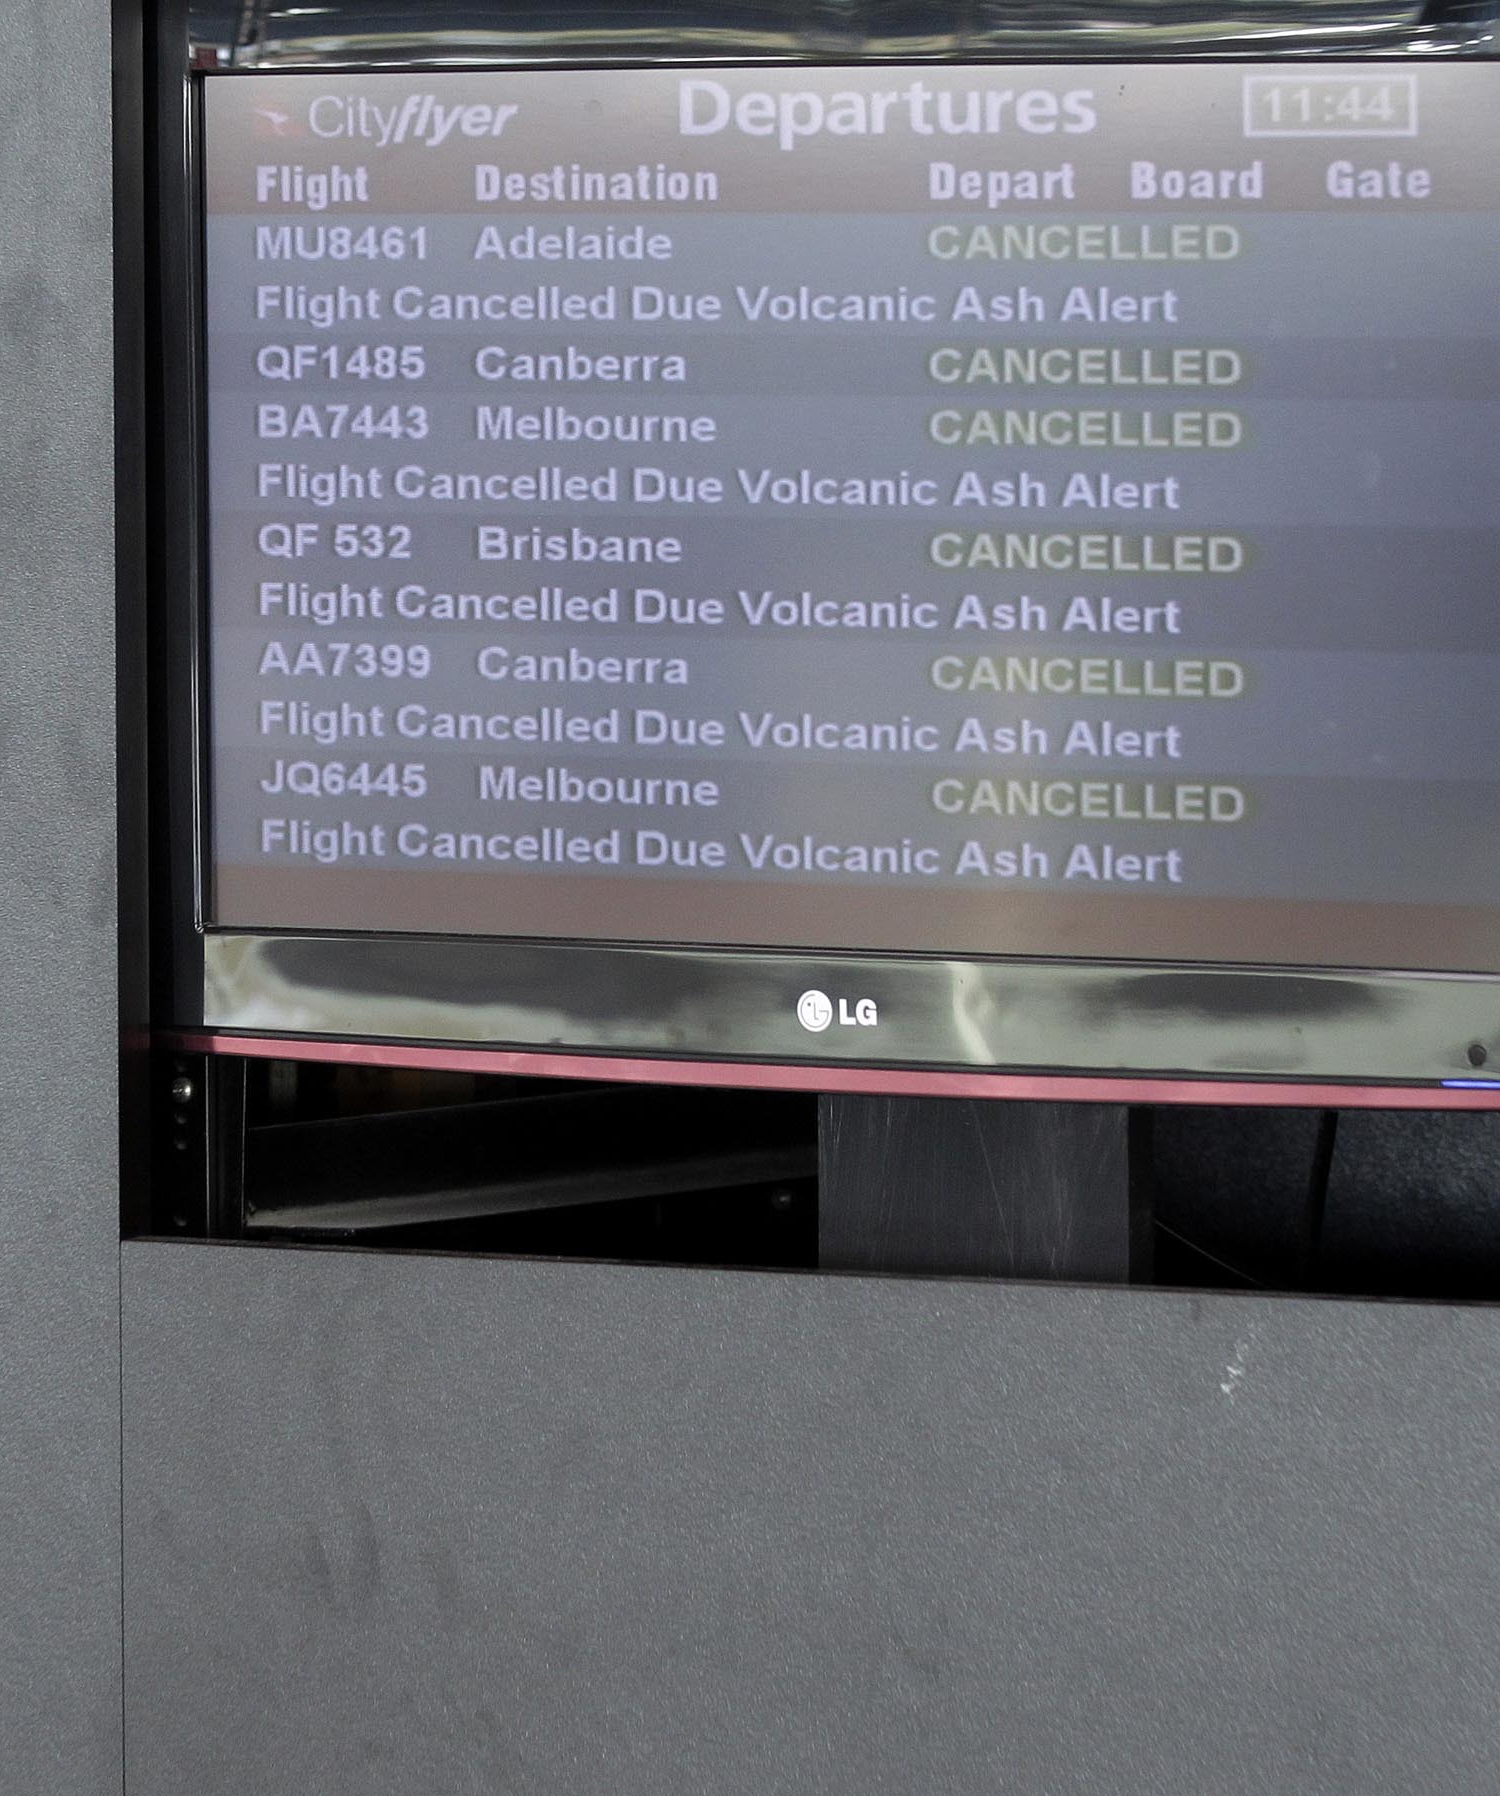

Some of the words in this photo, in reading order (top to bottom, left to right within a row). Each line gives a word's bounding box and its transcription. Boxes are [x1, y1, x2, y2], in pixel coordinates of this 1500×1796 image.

[309, 95, 517, 146] Cityflyer
[679, 80, 1097, 151] Departures
[1261, 87, 1395, 123] 11:44
[256, 165, 369, 209] Flight
[475, 165, 718, 201] Destination
[929, 161, 1075, 208] Depart
[1131, 161, 1263, 199] Board
[1326, 161, 1431, 198] Gate
[256, 227, 428, 260] MU8461
[474, 226, 672, 260] Adelaide
[928, 225, 1240, 260] CANCELLED
[257, 287, 380, 327] Flight
[393, 286, 616, 321] Cancelled
[632, 287, 721, 321] Due
[736, 287, 935, 322] Volcanic
[951, 287, 1044, 322] Ash
[1060, 287, 1178, 322] Alert
[257, 346, 425, 381] QF1485
[475, 346, 686, 382] Canberra
[929, 348, 1241, 385] CANCELLED
[257, 405, 429, 439] BA7443
[477, 406, 717, 441] Melbourne
[930, 411, 1241, 447] CANCELLED
[257, 464, 381, 506] Flight
[395, 465, 616, 501] Cancelled
[633, 468, 723, 503] Due
[738, 469, 937, 506] Volcanic
[953, 471, 1046, 507] Ash
[1062, 472, 1180, 509] Alert
[258, 523, 318, 559] QF
[334, 524, 411, 559] 532
[478, 527, 682, 563] Brisbane
[931, 533, 1242, 572] CANCELLED
[258, 583, 383, 625] Flight
[396, 585, 618, 622] Cancelled
[635, 589, 724, 625] Due
[739, 591, 938, 629] Volcanic
[954, 595, 1047, 632] Ash
[1062, 596, 1181, 634] Alert
[258, 643, 430, 678] AA7399
[478, 646, 688, 685] Canberra
[932, 656, 1243, 697] CANCELLED
[260, 701, 384, 744] Flight
[396, 705, 619, 744] Cancelled
[635, 710, 725, 747] Due
[739, 712, 939, 752] Volcanic
[955, 718, 1048, 755] Ash
[1064, 720, 1181, 758] Alert
[261, 761, 426, 798] JQ6445
[479, 766, 719, 806] Melbourne
[933, 779, 1244, 822] CANCELLED
[261, 819, 385, 862] Flight
[397, 823, 620, 864] Cancelled
[636, 831, 726, 868] Due
[740, 833, 940, 875] Volcanic
[955, 841, 1049, 879] Ash
[1065, 844, 1183, 883] Alert
[839, 999, 877, 1026] LG
